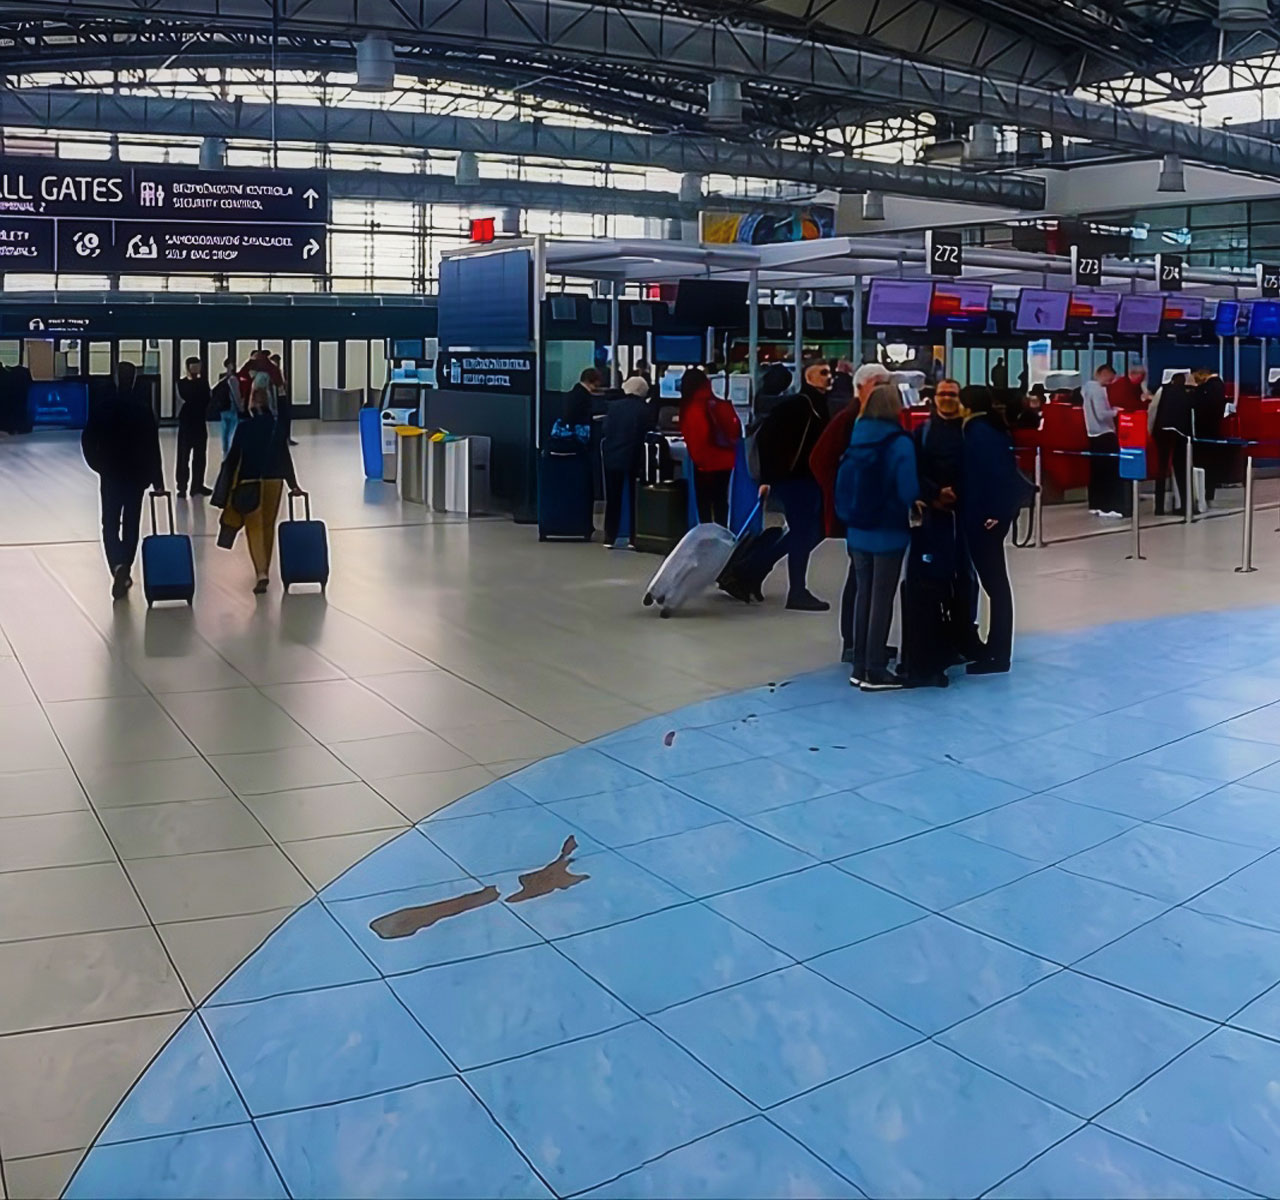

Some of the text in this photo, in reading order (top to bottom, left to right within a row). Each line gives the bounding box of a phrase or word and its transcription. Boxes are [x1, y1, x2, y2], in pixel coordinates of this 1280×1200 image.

[0, 174, 123, 202] LL GATES
[934, 244, 959, 263] 272
[1079, 258, 1099, 274] 273
